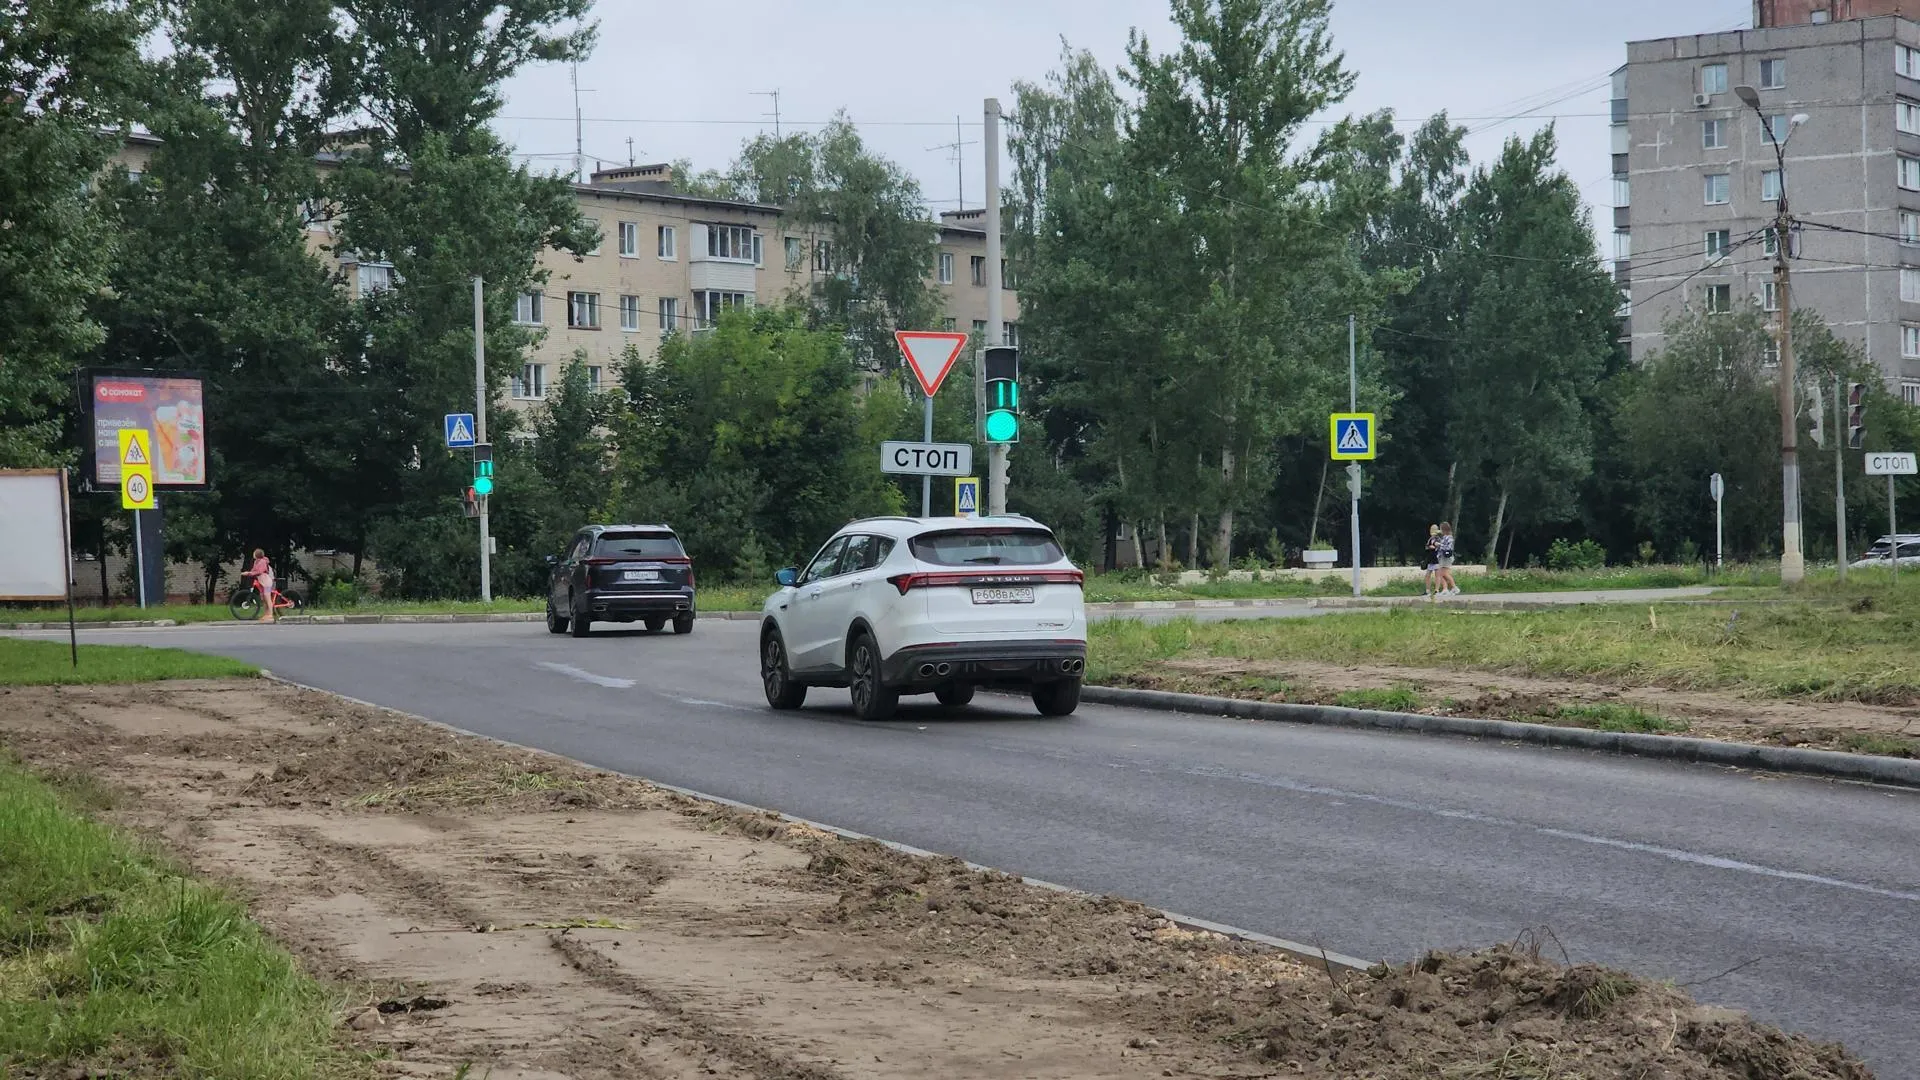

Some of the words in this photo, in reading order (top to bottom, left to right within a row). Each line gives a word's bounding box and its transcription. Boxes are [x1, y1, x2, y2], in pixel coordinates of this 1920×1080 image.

[894, 448, 958, 469] СТОП
[1873, 456, 1910, 470] СТОП
[131, 482, 144, 494] 40
